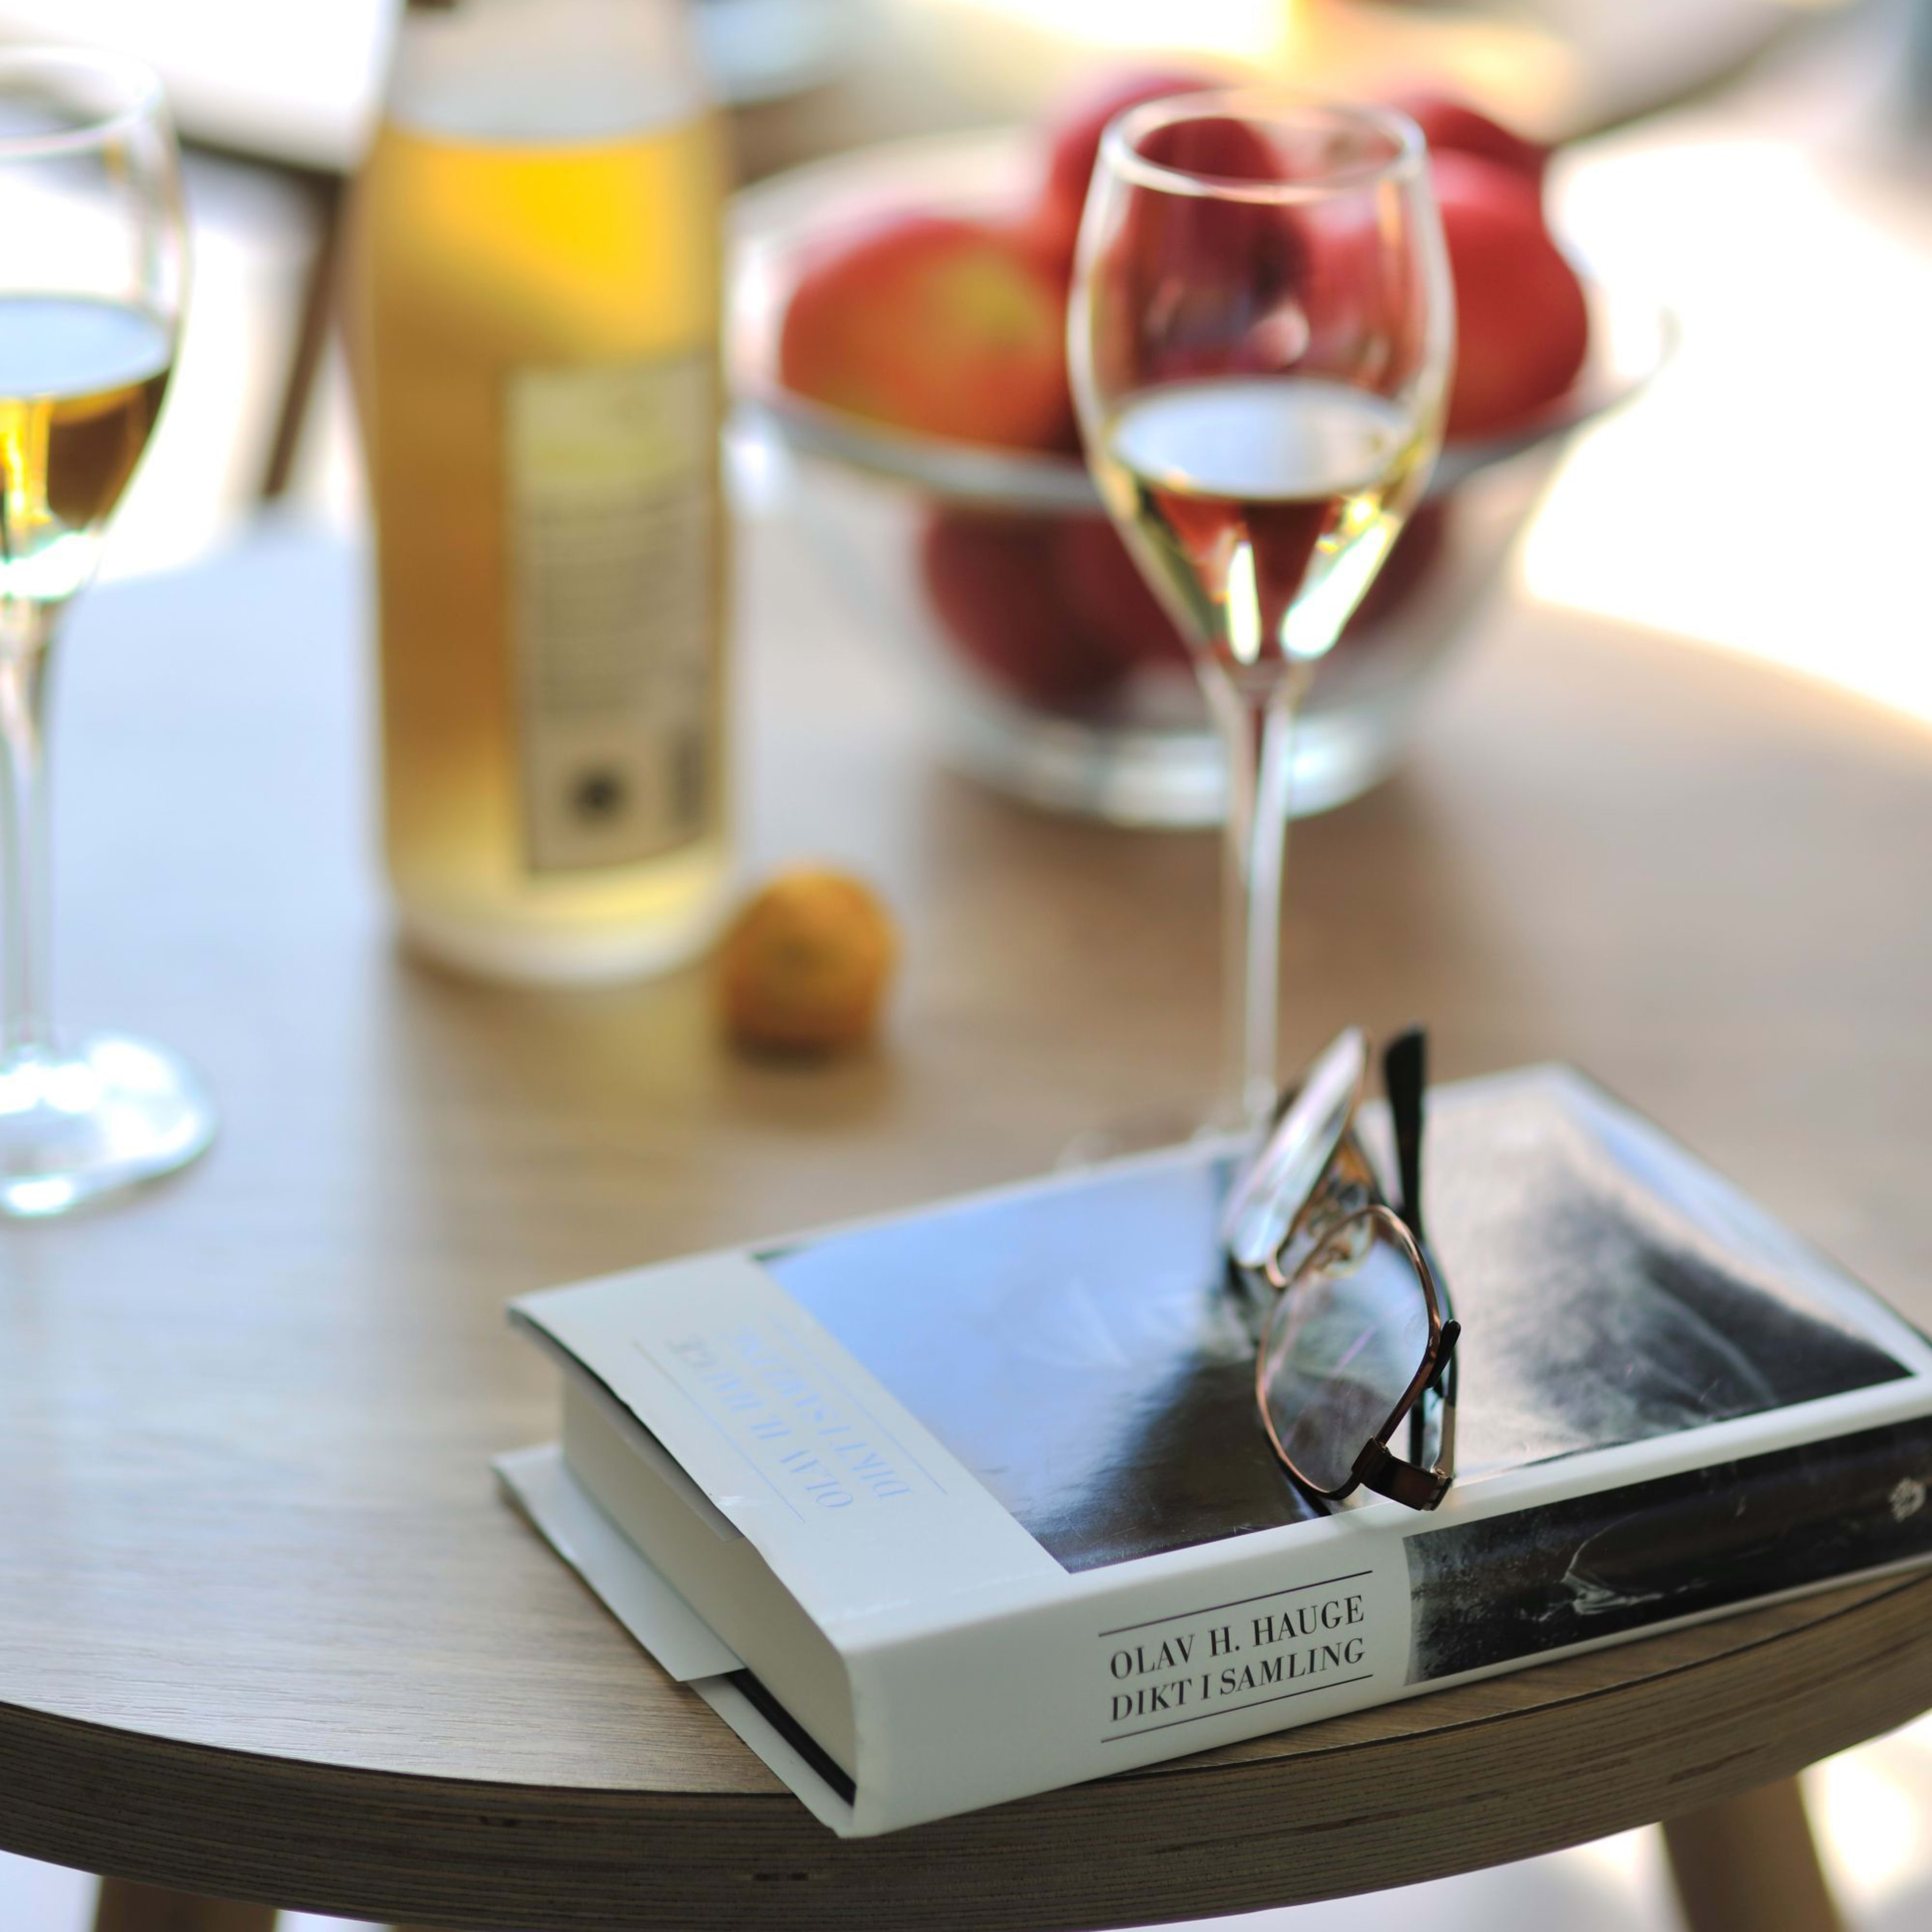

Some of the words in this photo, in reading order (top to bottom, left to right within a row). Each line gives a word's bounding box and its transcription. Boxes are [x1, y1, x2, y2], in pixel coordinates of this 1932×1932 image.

[774, 1449, 856, 1509] OLAV
[828, 1437, 912, 1499] DIKT
[1110, 1635, 1195, 1679] OLAV
[1209, 1626, 1240, 1657] H.
[1252, 1595, 1364, 1647] HAUGE
[1110, 1679, 1192, 1722] DIKT
[1200, 1674, 1212, 1701] I
[1220, 1638, 1365, 1696] SAMLING
